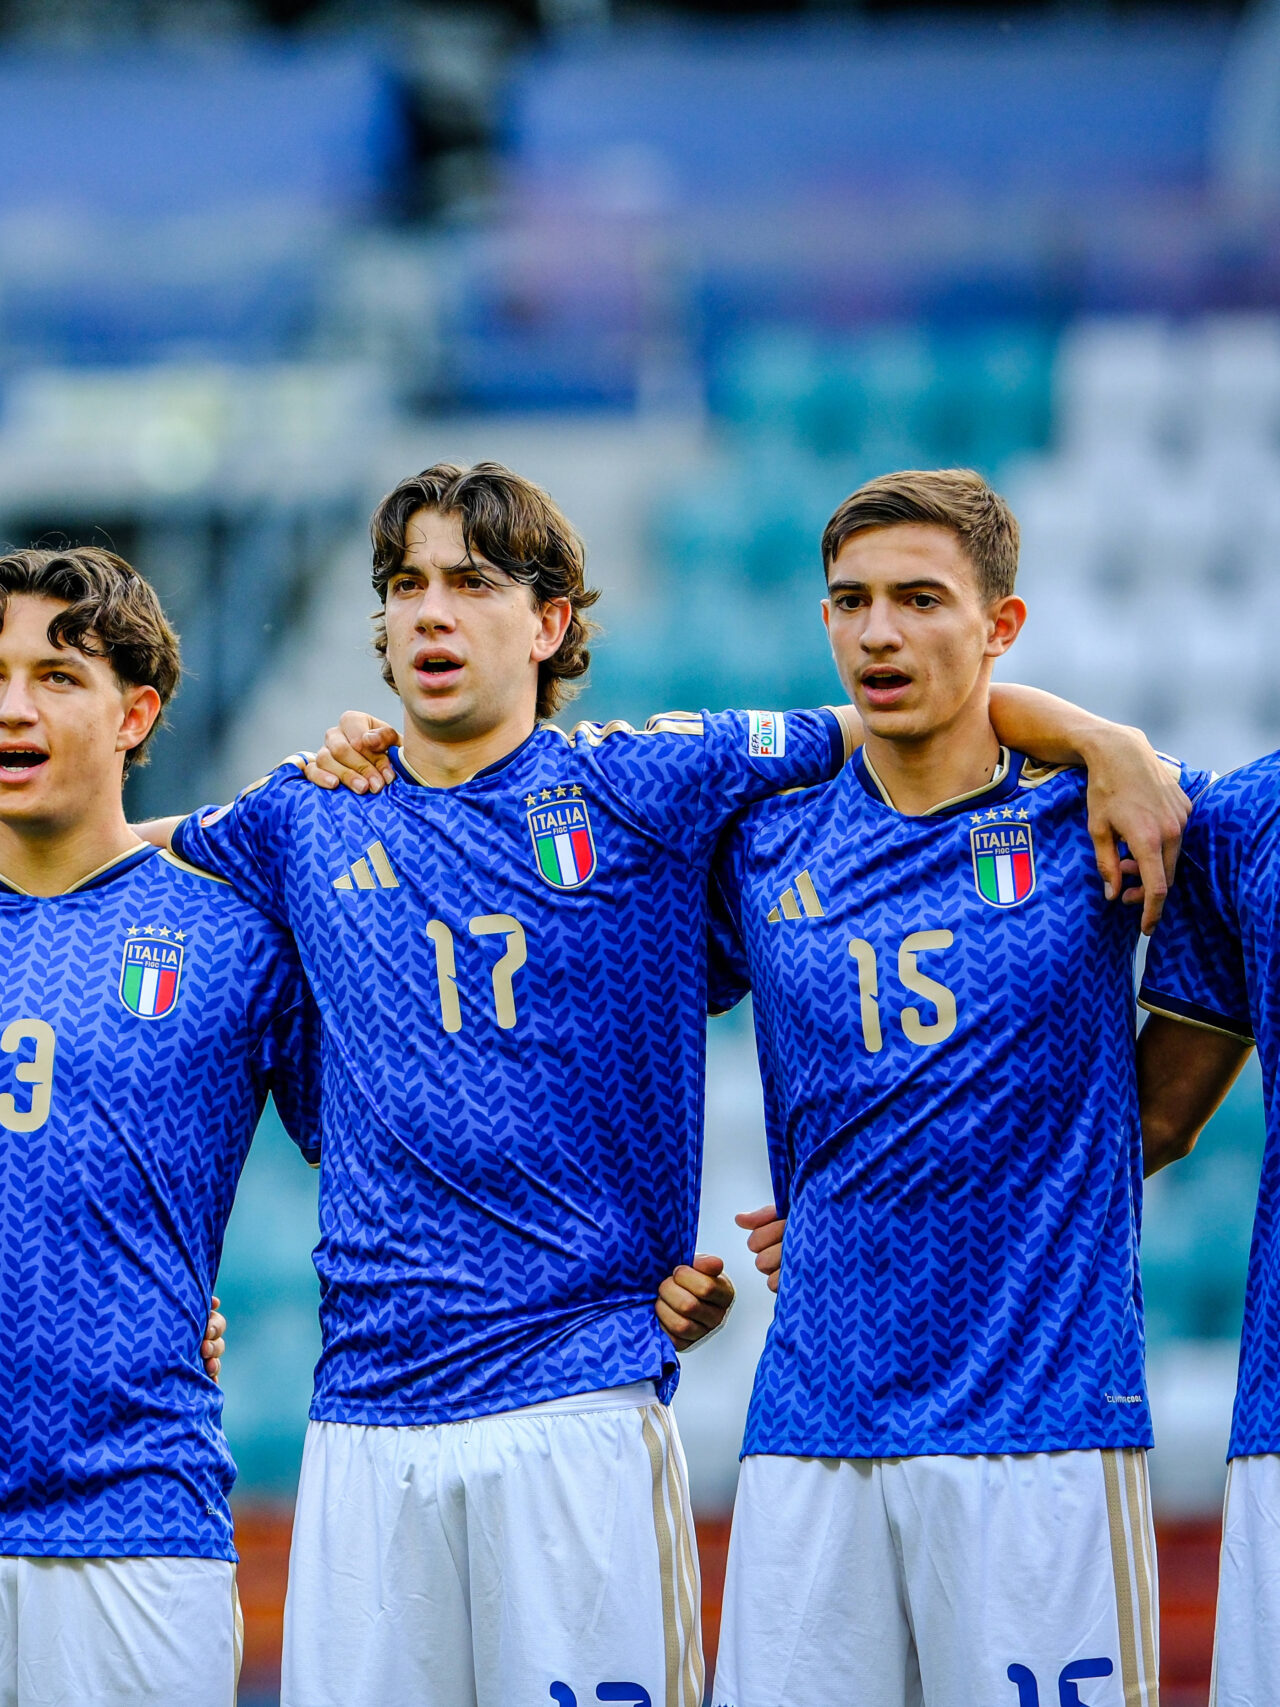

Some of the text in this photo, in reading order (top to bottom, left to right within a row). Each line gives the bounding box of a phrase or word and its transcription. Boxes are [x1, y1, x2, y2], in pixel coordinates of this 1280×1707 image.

[532, 807, 584, 832] ITALIA
[975, 830, 1027, 849] ITALIA
[128, 944, 178, 965] ITALIA
[426, 913, 527, 1033] 17
[849, 929, 957, 1052] 15
